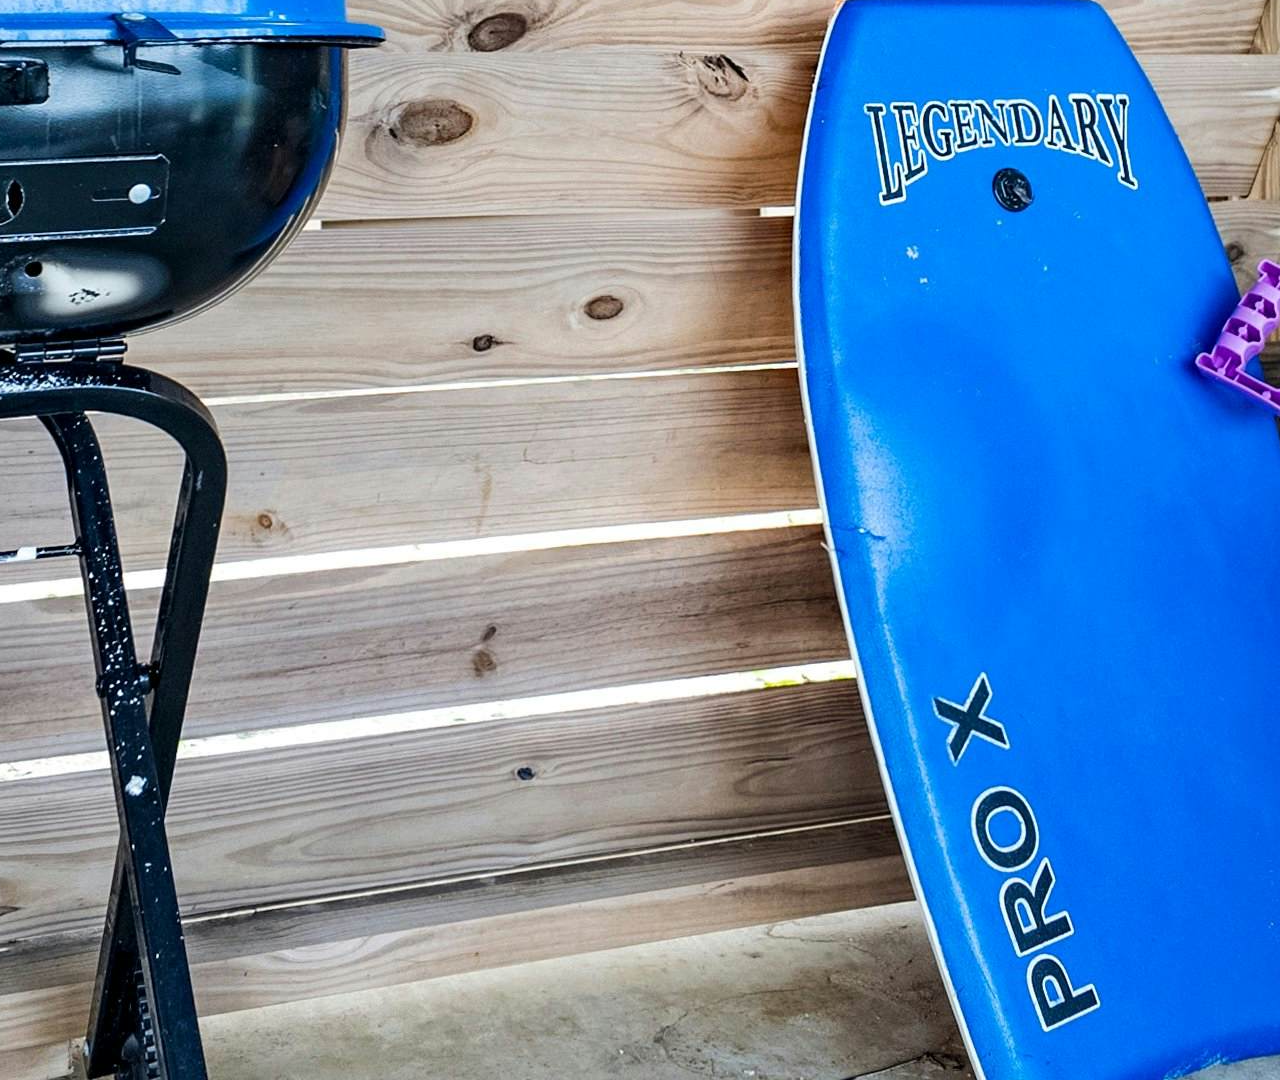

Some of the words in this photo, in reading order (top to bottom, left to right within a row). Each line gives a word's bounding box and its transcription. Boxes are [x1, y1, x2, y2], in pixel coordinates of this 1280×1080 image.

[865, 93, 1138, 206] LEGENDARY
[932, 671, 1010, 767] X
[970, 785, 1101, 1032] PRO
